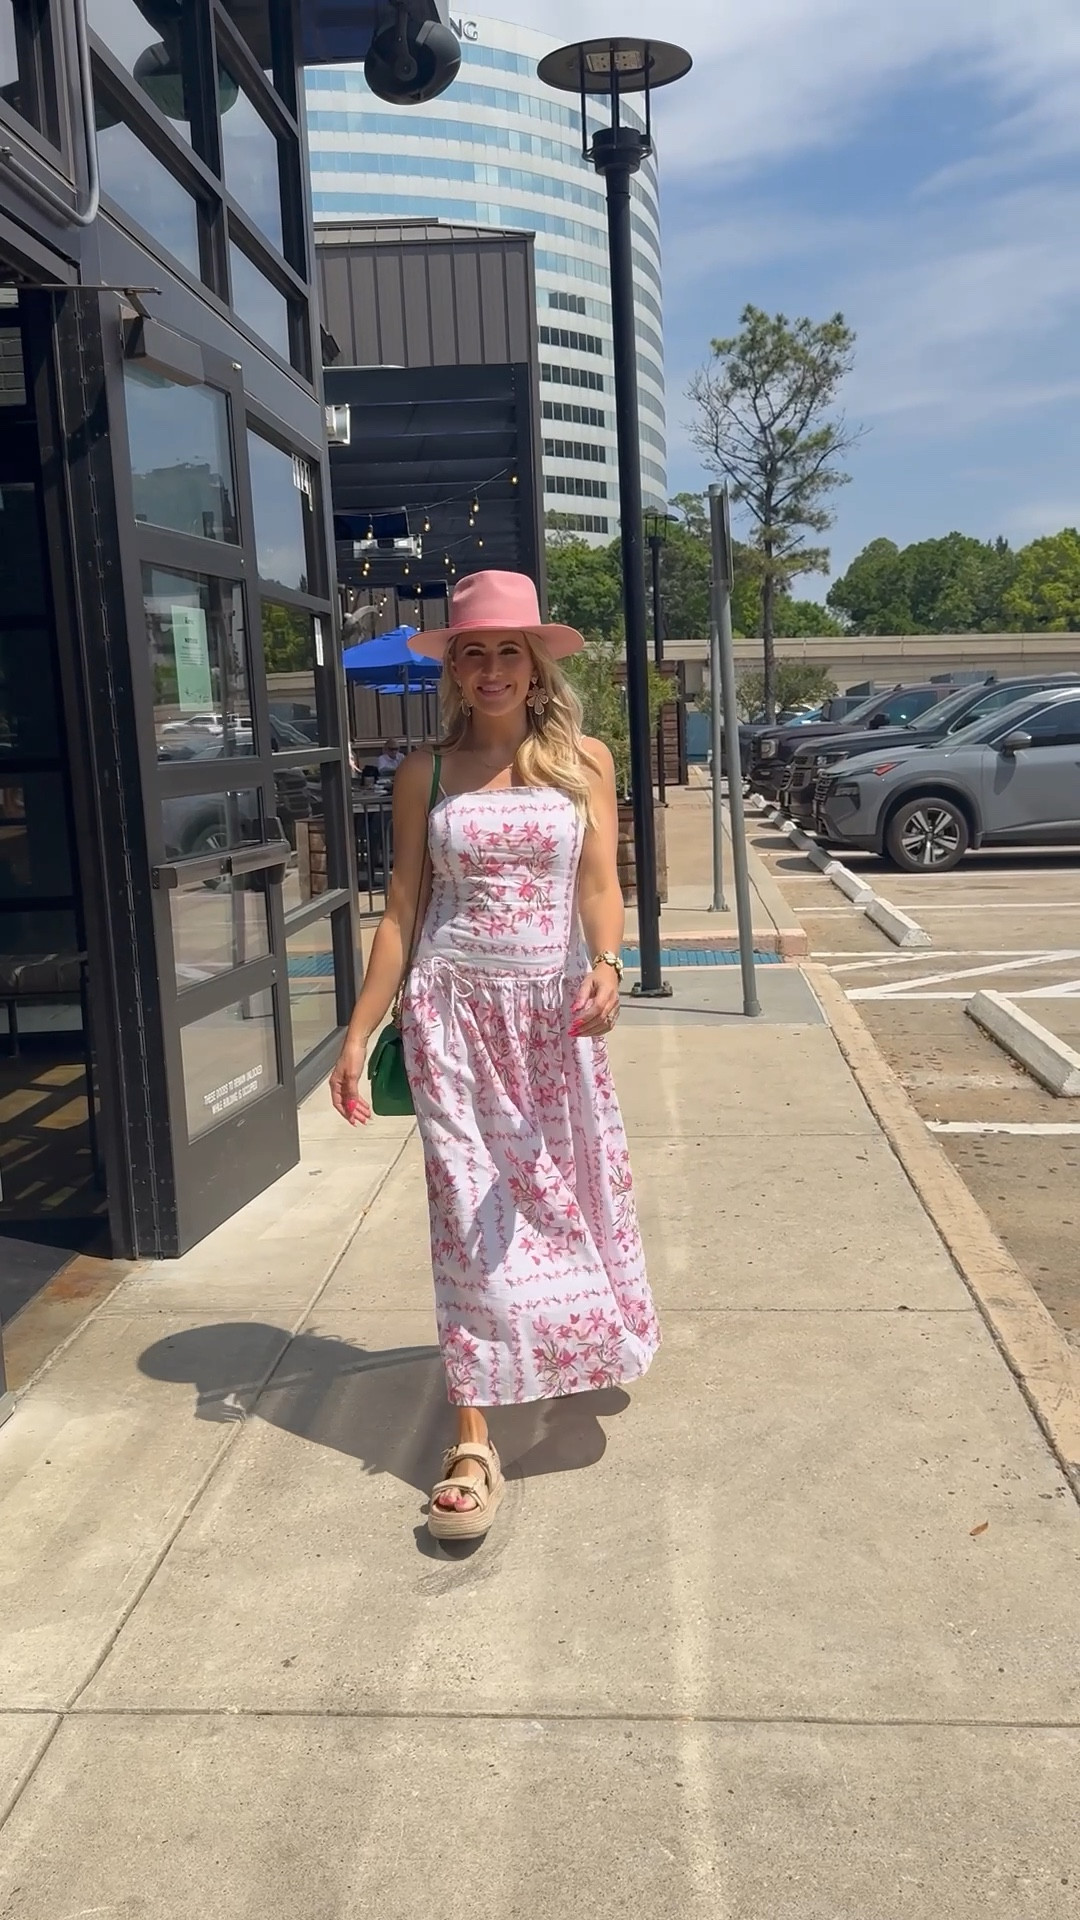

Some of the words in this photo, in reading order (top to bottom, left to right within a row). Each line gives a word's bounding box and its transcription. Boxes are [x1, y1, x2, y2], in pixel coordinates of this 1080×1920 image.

[204, 1090, 216, 1105] THESE
[216, 1083, 228, 1099] DOORS
[234, 1074, 246, 1089] REMAIN
[246, 1064, 263, 1081] UNLOCKED
[223, 1092, 239, 1108] BUILDING
[242, 1080, 258, 1097] OCCUPIED
